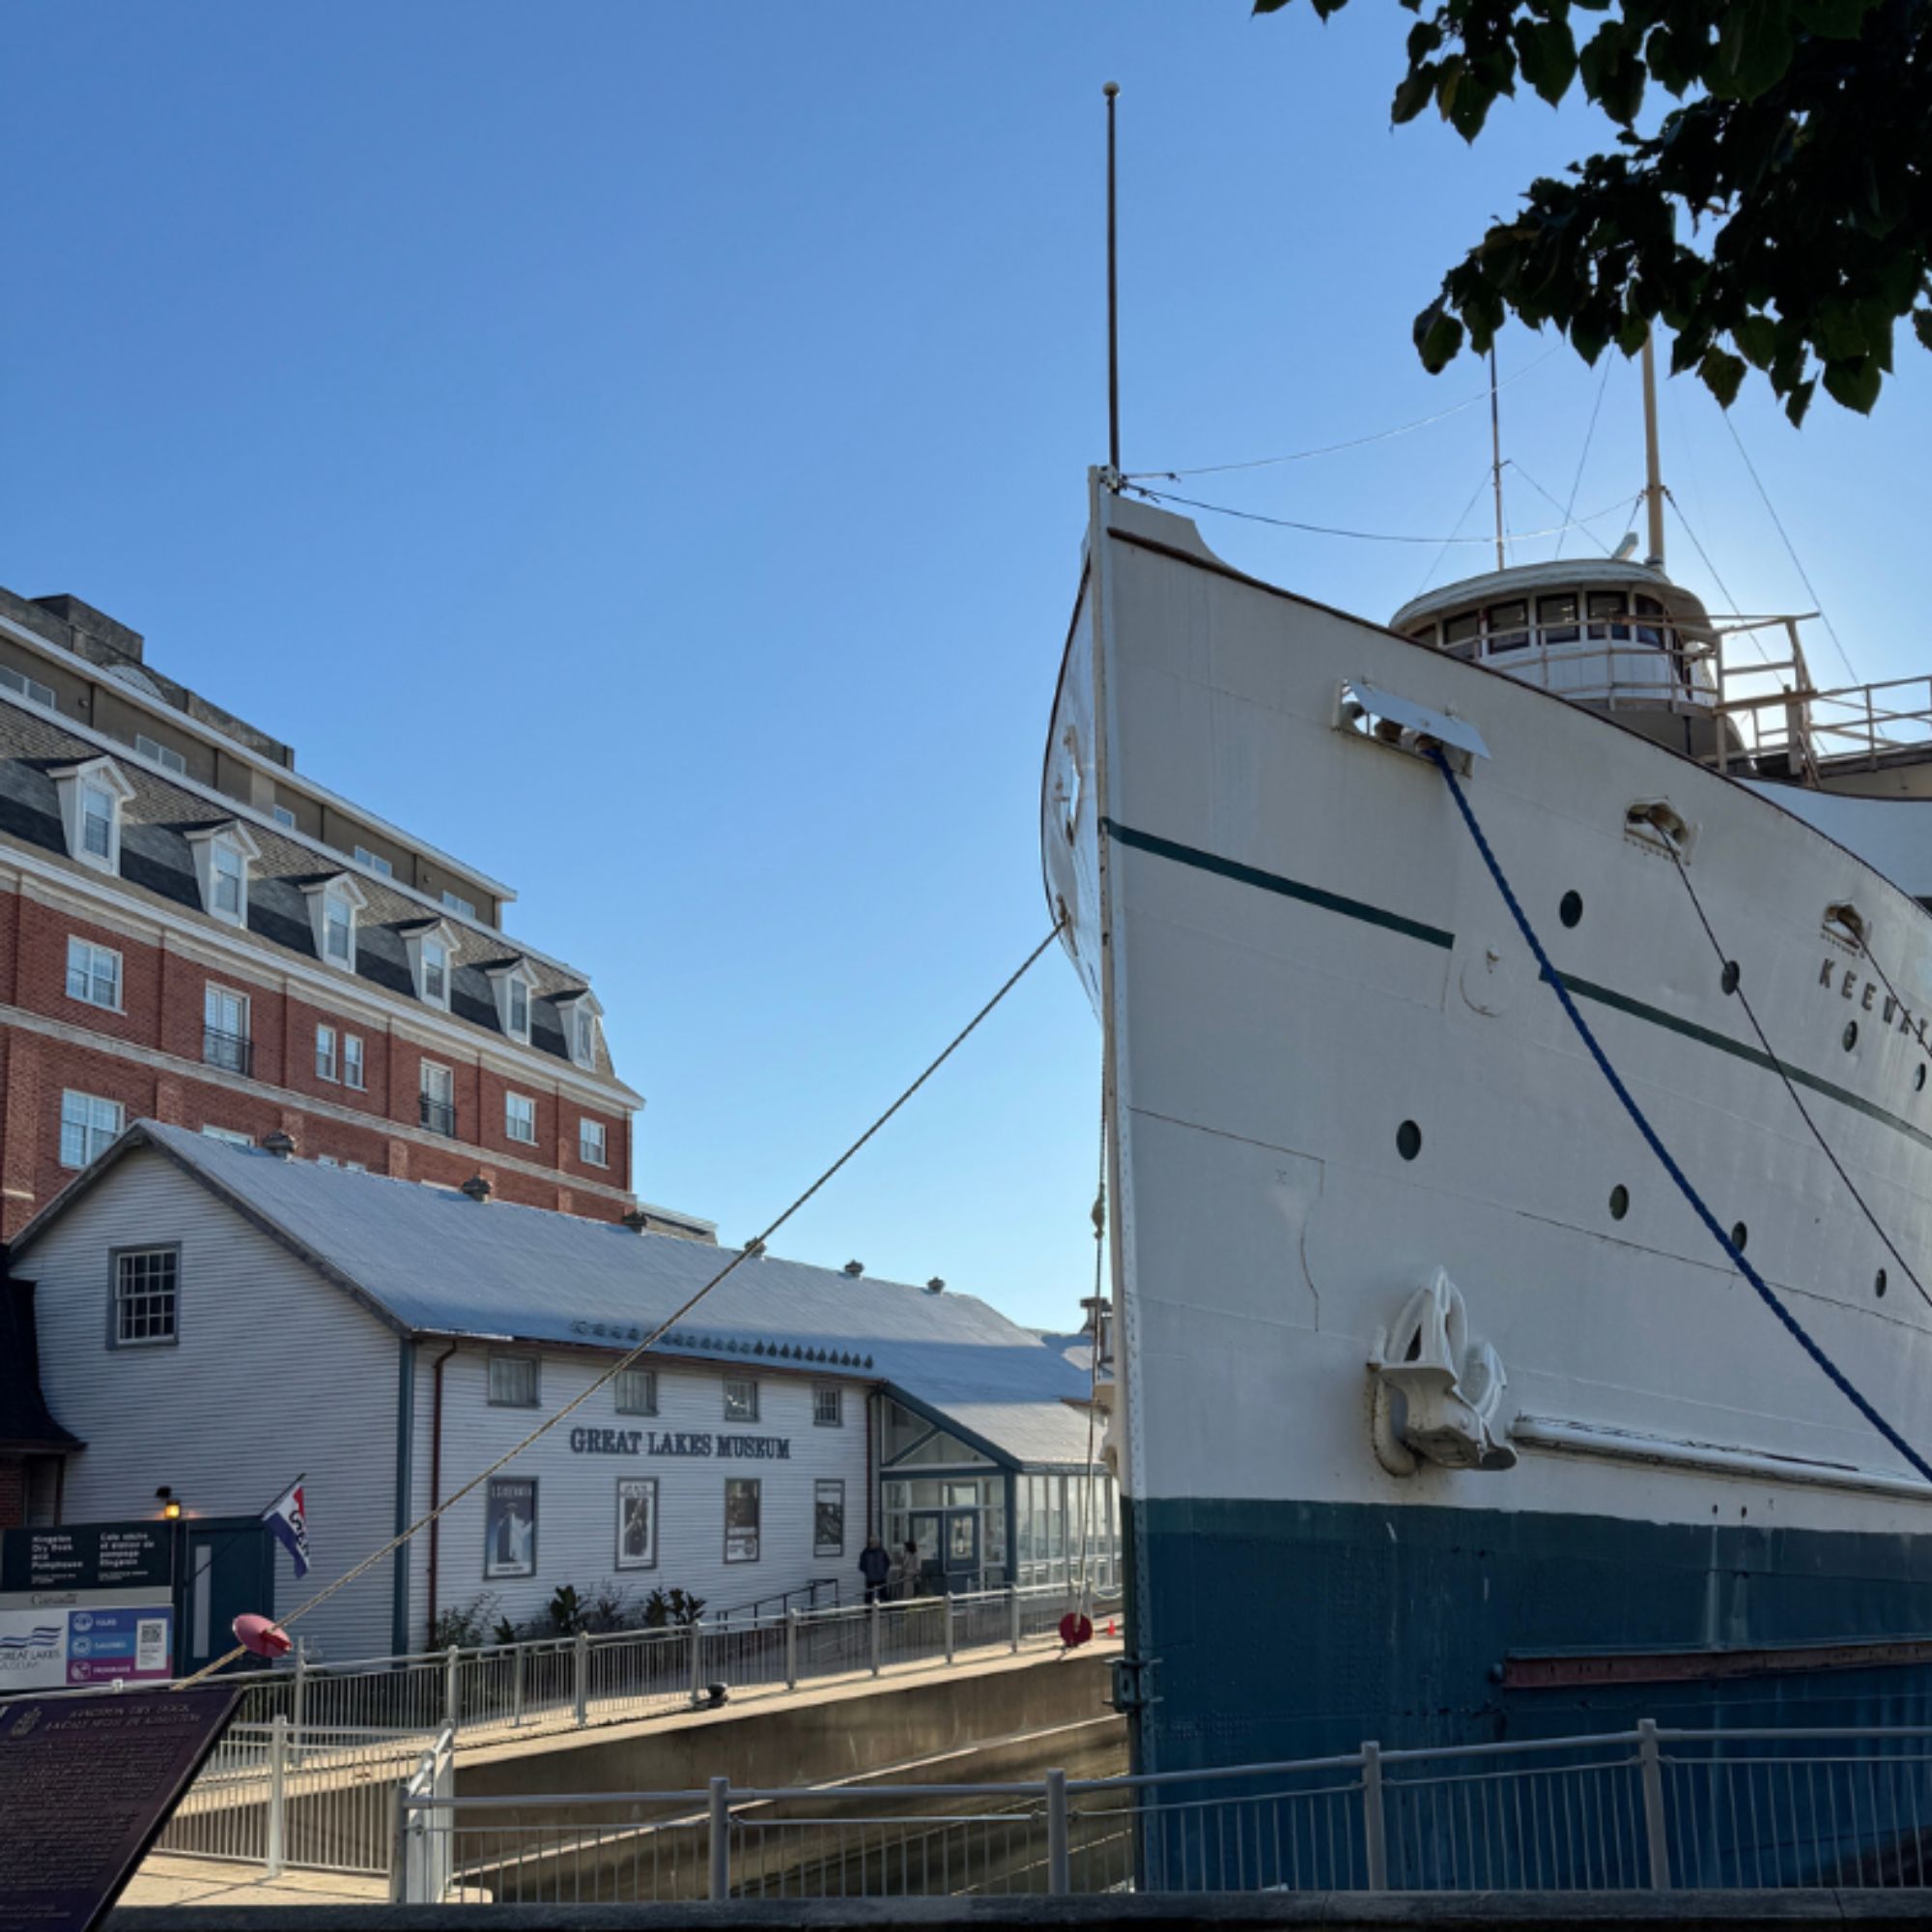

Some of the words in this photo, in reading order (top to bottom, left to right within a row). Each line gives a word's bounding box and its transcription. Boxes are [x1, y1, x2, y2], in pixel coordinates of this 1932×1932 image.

[1819, 958, 1932, 1057] KEEWAT
[570, 1427, 642, 1455] GREAT
[647, 1431, 713, 1458] LAKES
[716, 1435, 790, 1460] MUSEUM
